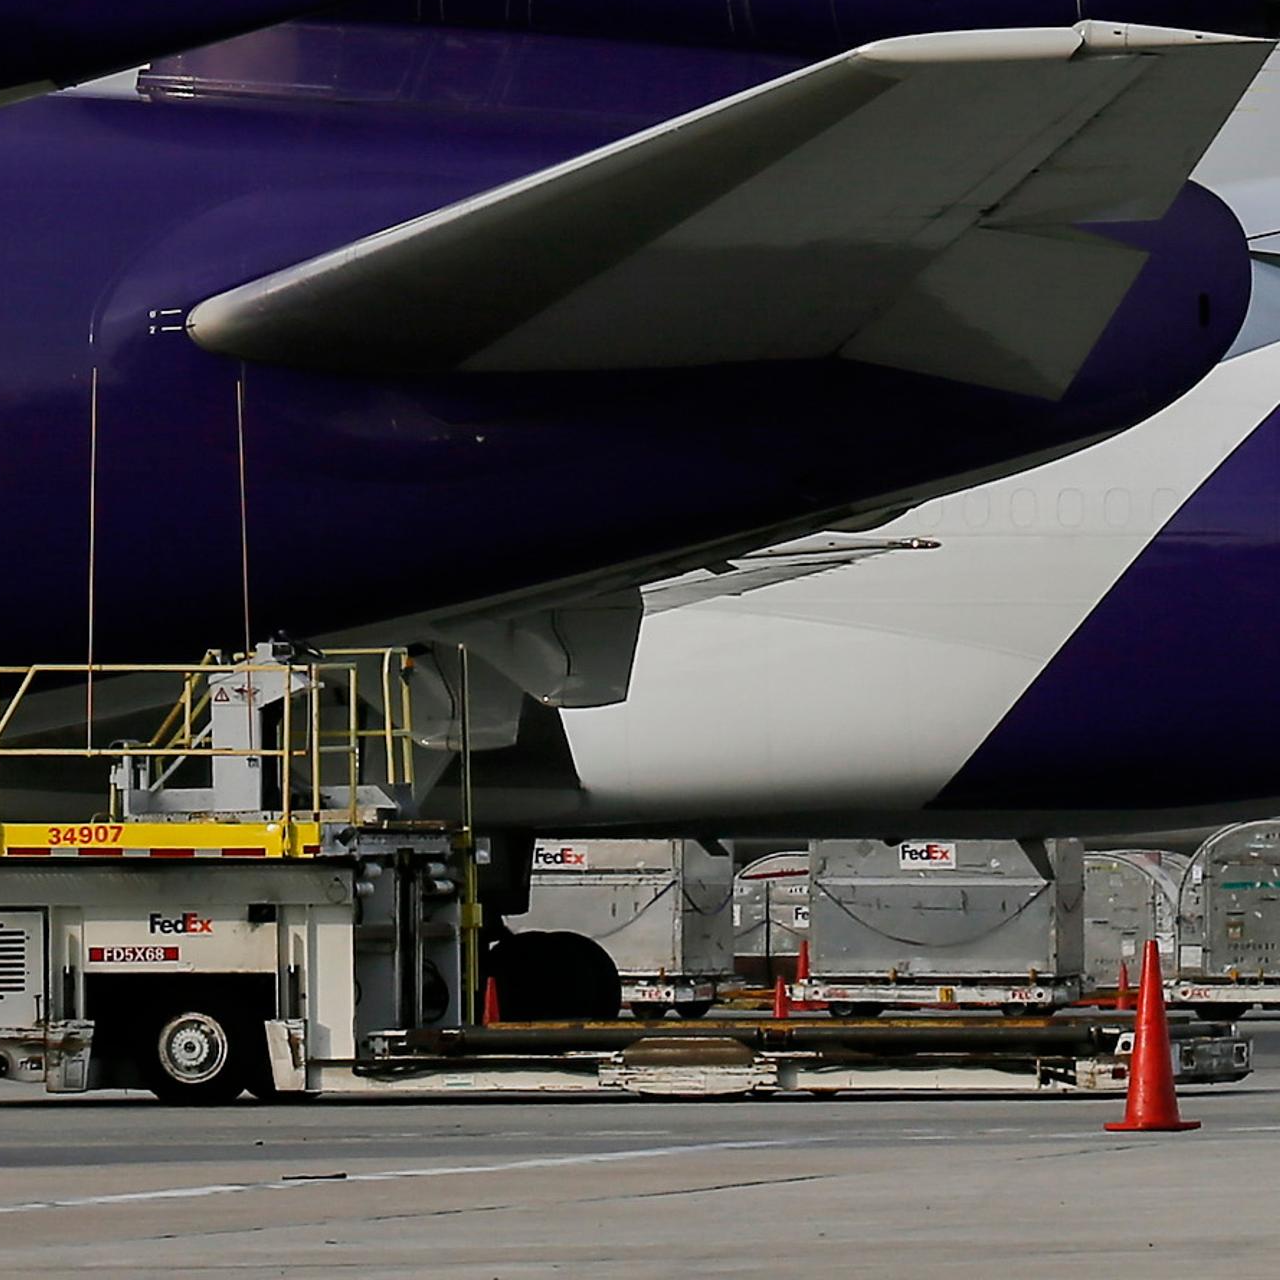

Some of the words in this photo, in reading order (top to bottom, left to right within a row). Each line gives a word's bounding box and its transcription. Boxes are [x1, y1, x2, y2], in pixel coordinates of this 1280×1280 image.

[47, 825, 126, 845] 34907
[535, 847, 585, 865] FedEx
[900, 844, 951, 861] FedEx
[149, 912, 213, 934] FedEx
[103, 946, 165, 963] FD5X68
